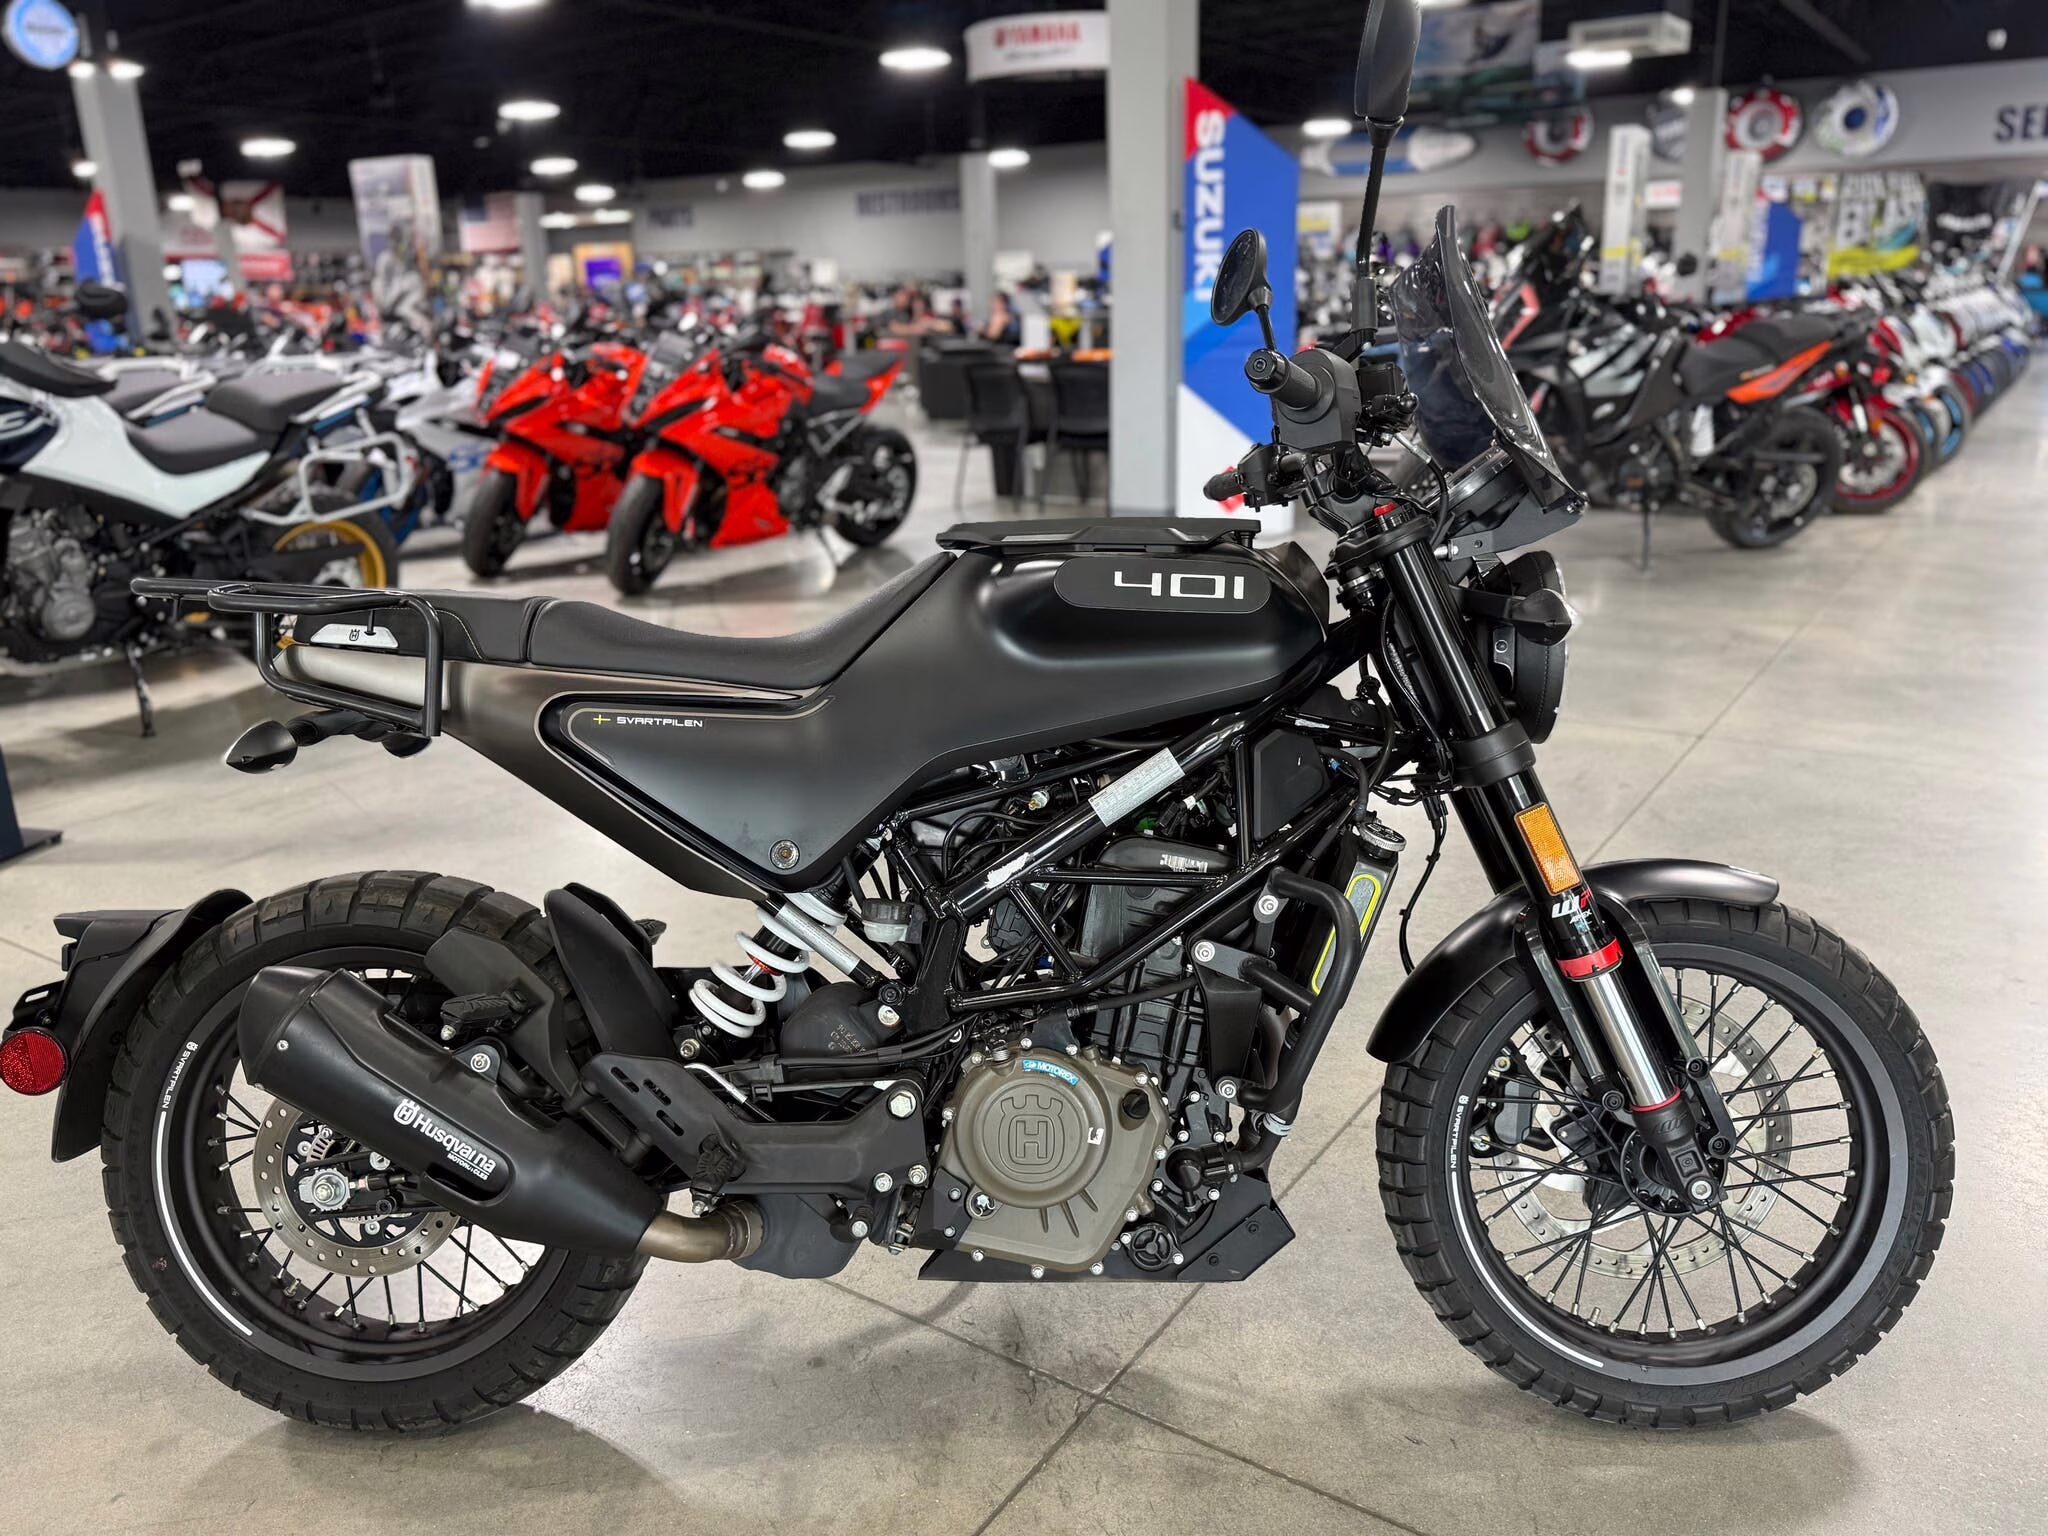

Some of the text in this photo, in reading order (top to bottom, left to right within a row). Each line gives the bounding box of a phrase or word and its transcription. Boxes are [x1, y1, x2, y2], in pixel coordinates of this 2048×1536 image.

[1994, 102, 2048, 143] SE
[1194, 109, 1226, 303] SUZUKI
[1114, 571, 1245, 600] 401
[616, 716, 703, 728] SVARTPILEN
[161, 1050, 192, 1109] SVARTPILEN
[1037, 1061, 1079, 1085] MOTOREX
[412, 1113, 497, 1174] Husqvarna
[1450, 1105, 1465, 1169] SVARTPILEN
